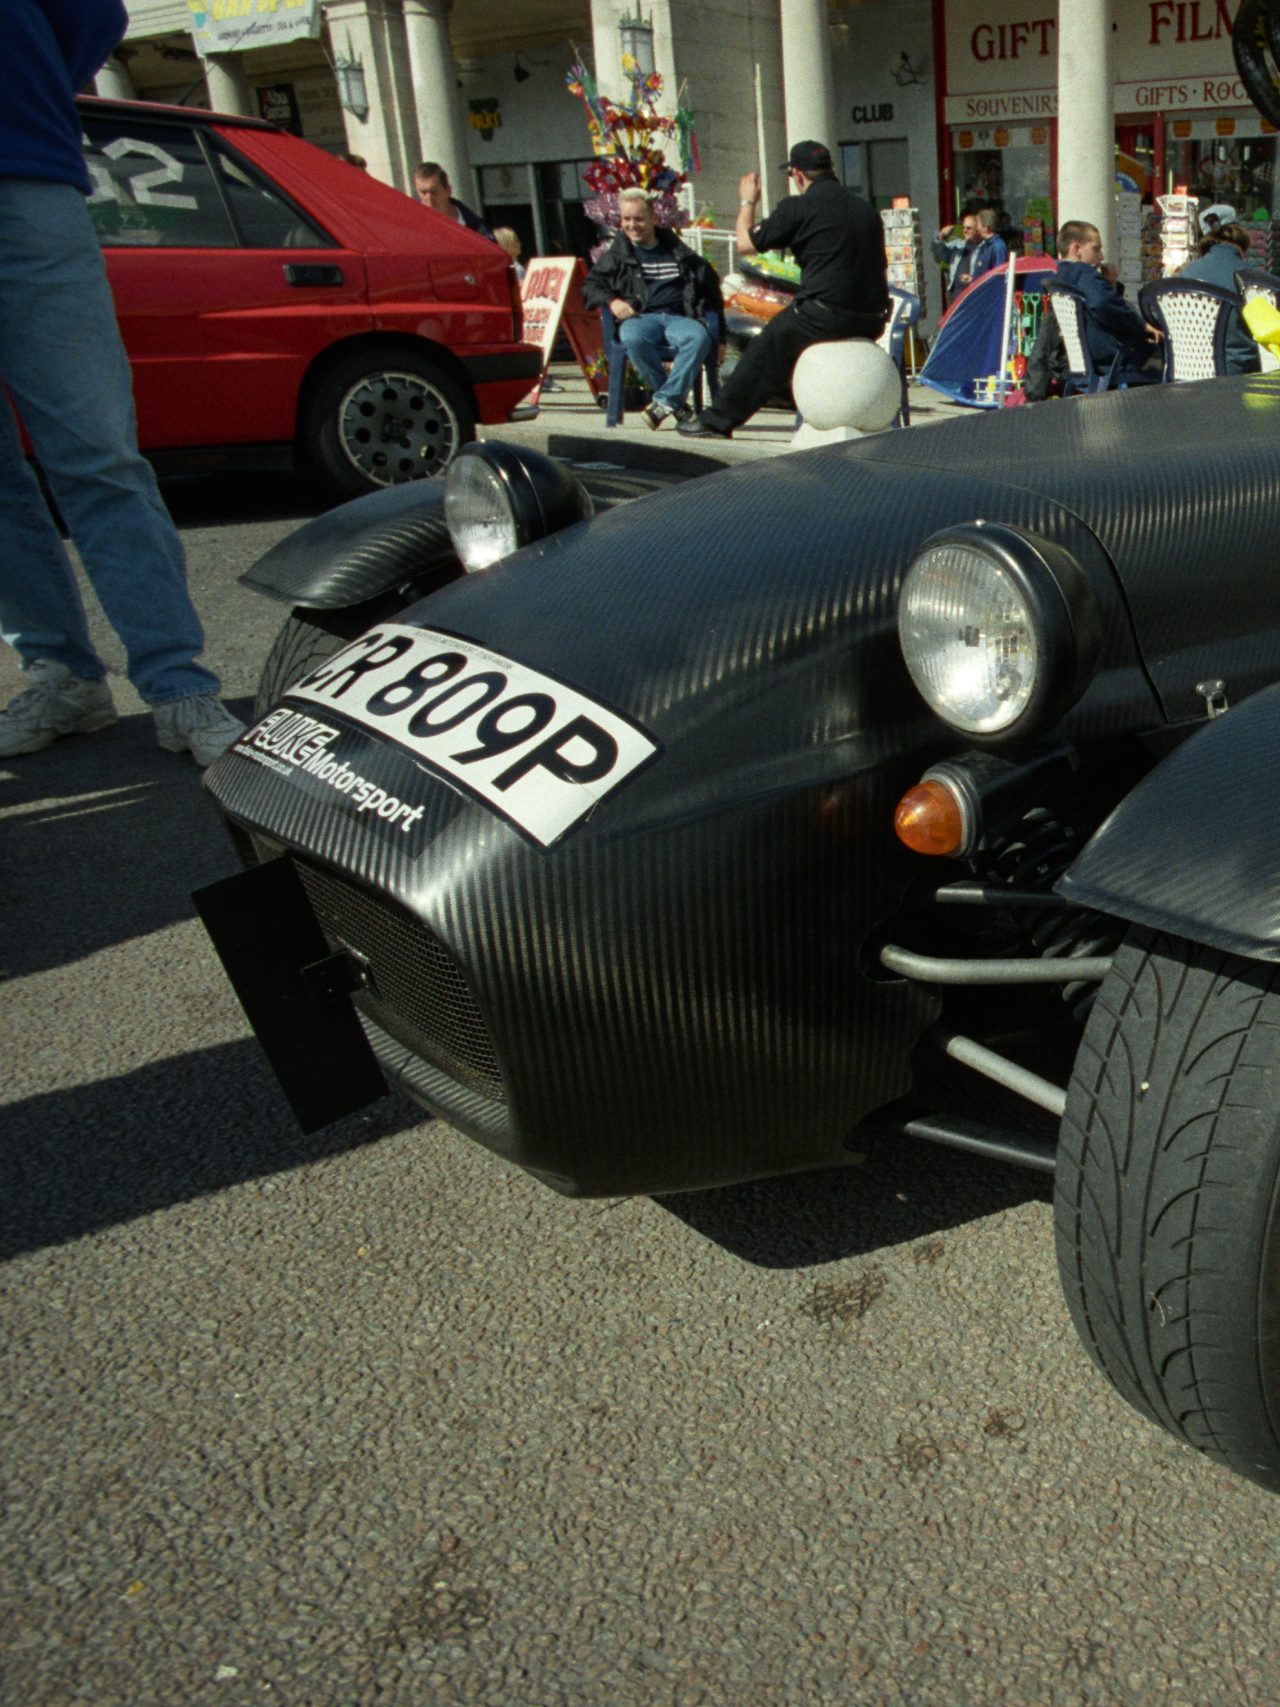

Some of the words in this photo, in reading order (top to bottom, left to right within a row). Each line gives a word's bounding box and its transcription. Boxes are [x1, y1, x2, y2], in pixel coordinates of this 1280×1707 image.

[851, 103, 894, 124] CLUB
[1135, 85, 1189, 107] GIFTS
[1202, 81, 1253, 104] ROC
[365, 651, 619, 792] 809P
[243, 708, 341, 766] FLUKE
[304, 745, 425, 832] Motorsport
